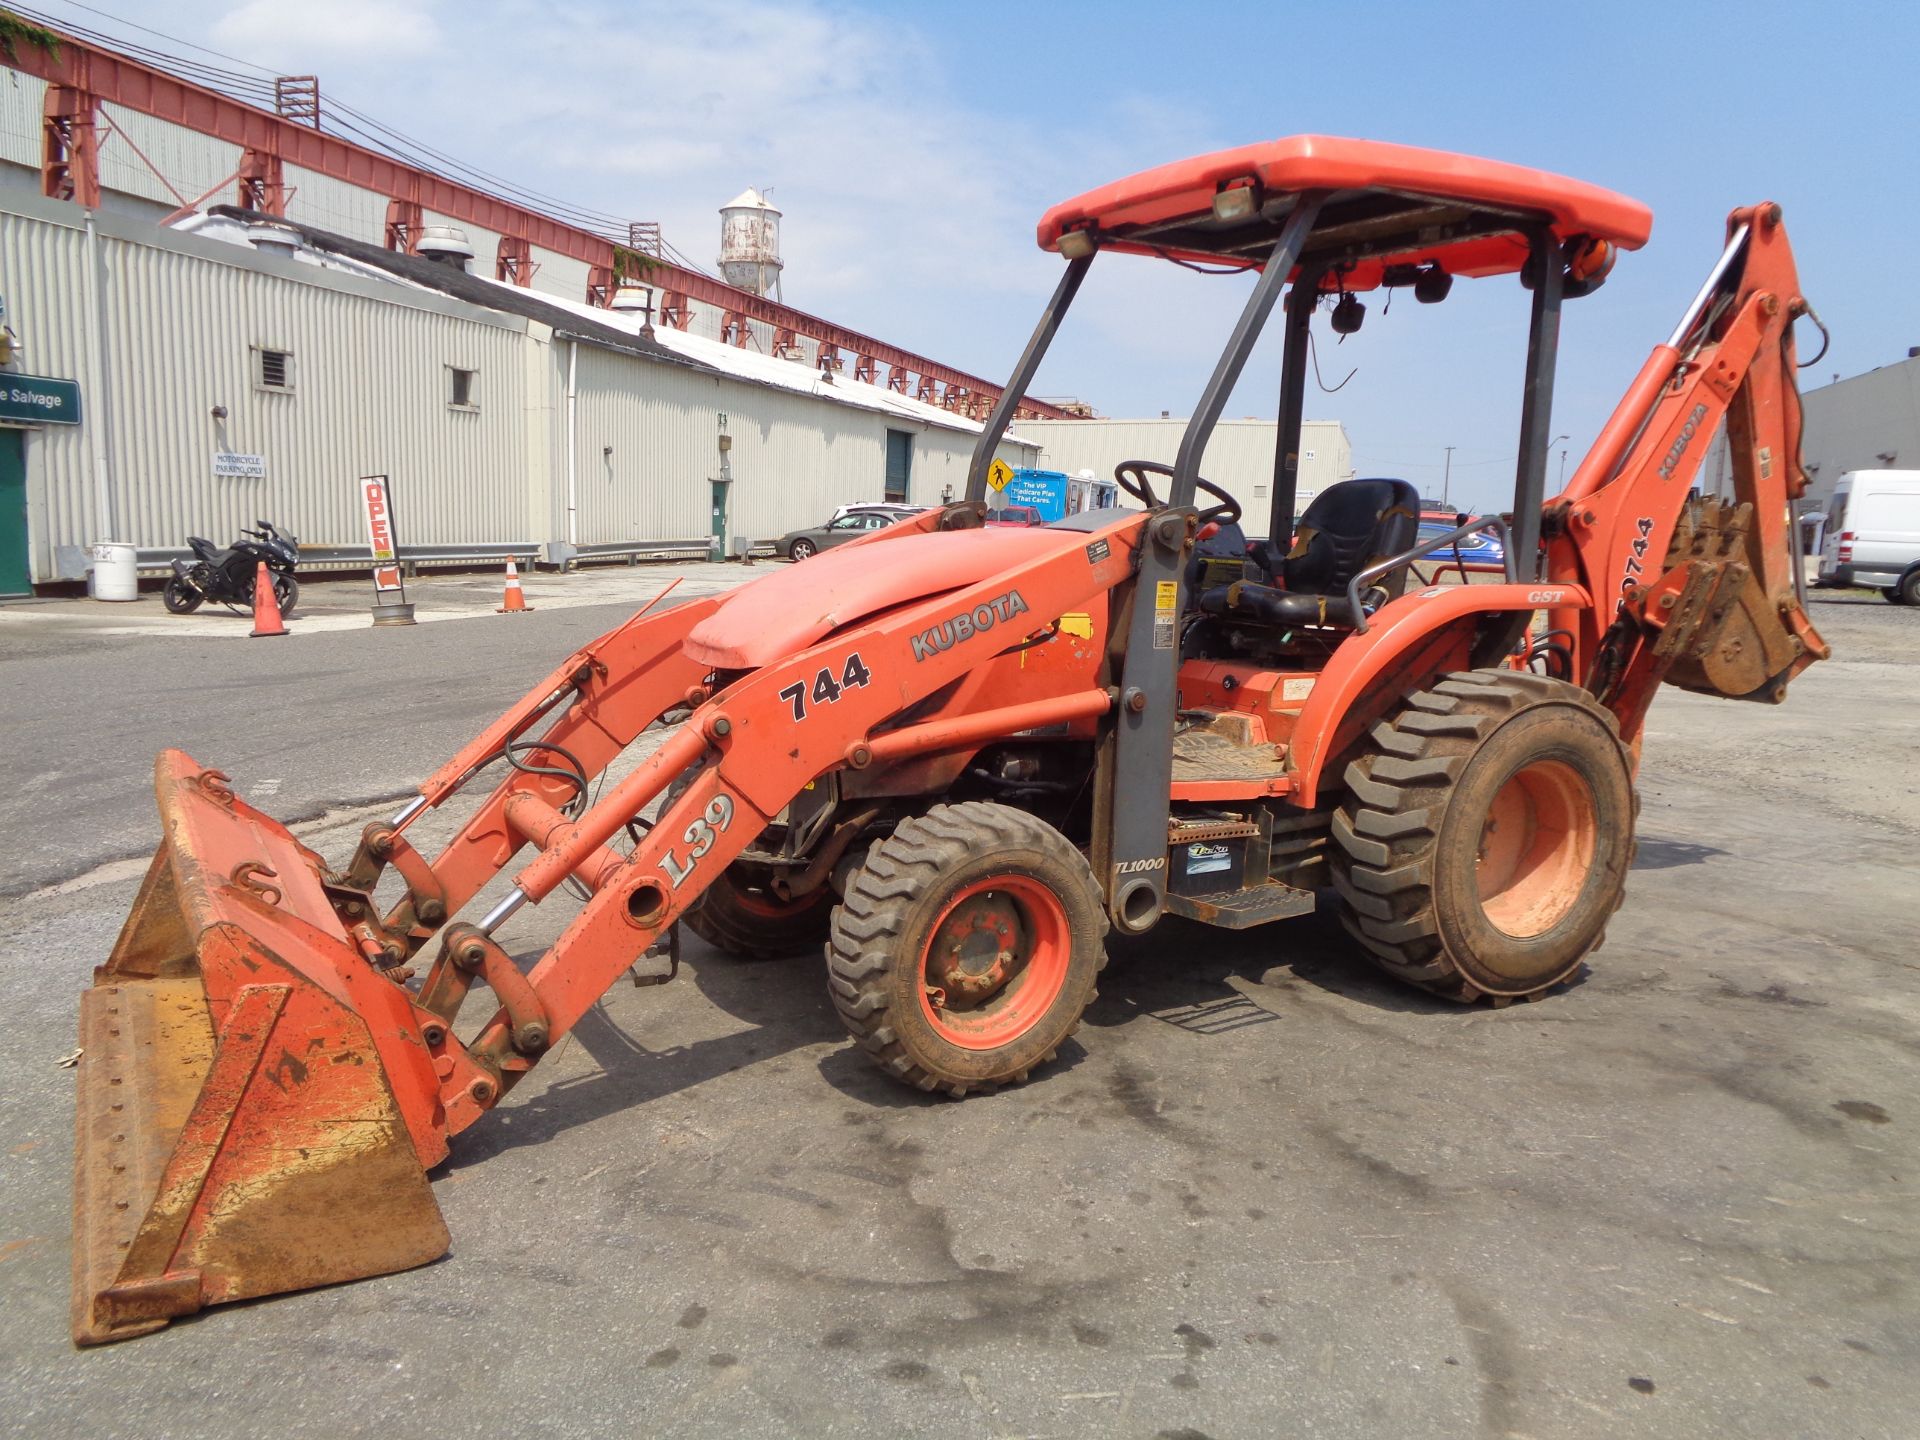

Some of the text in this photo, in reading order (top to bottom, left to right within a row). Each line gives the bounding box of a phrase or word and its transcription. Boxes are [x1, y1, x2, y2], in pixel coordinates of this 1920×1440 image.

[11, 388, 62, 409] Salvage
[717, 412, 727, 425] T3
[1658, 403, 1709, 481] KUBOTA
[217, 455, 261, 465] MOTORCYCLE
[215, 464, 263, 475] PARKING ONLY
[1017, 495, 1031, 503] That
[1041, 490, 1056, 498] Plan
[366, 483, 391, 551] OPEN
[1528, 591, 1565, 603] GST
[910, 589, 1030, 662] KUBOTA
[778, 652, 871, 722] 744
[657, 793, 735, 890] L39
[1115, 857, 1164, 874] TL1000
